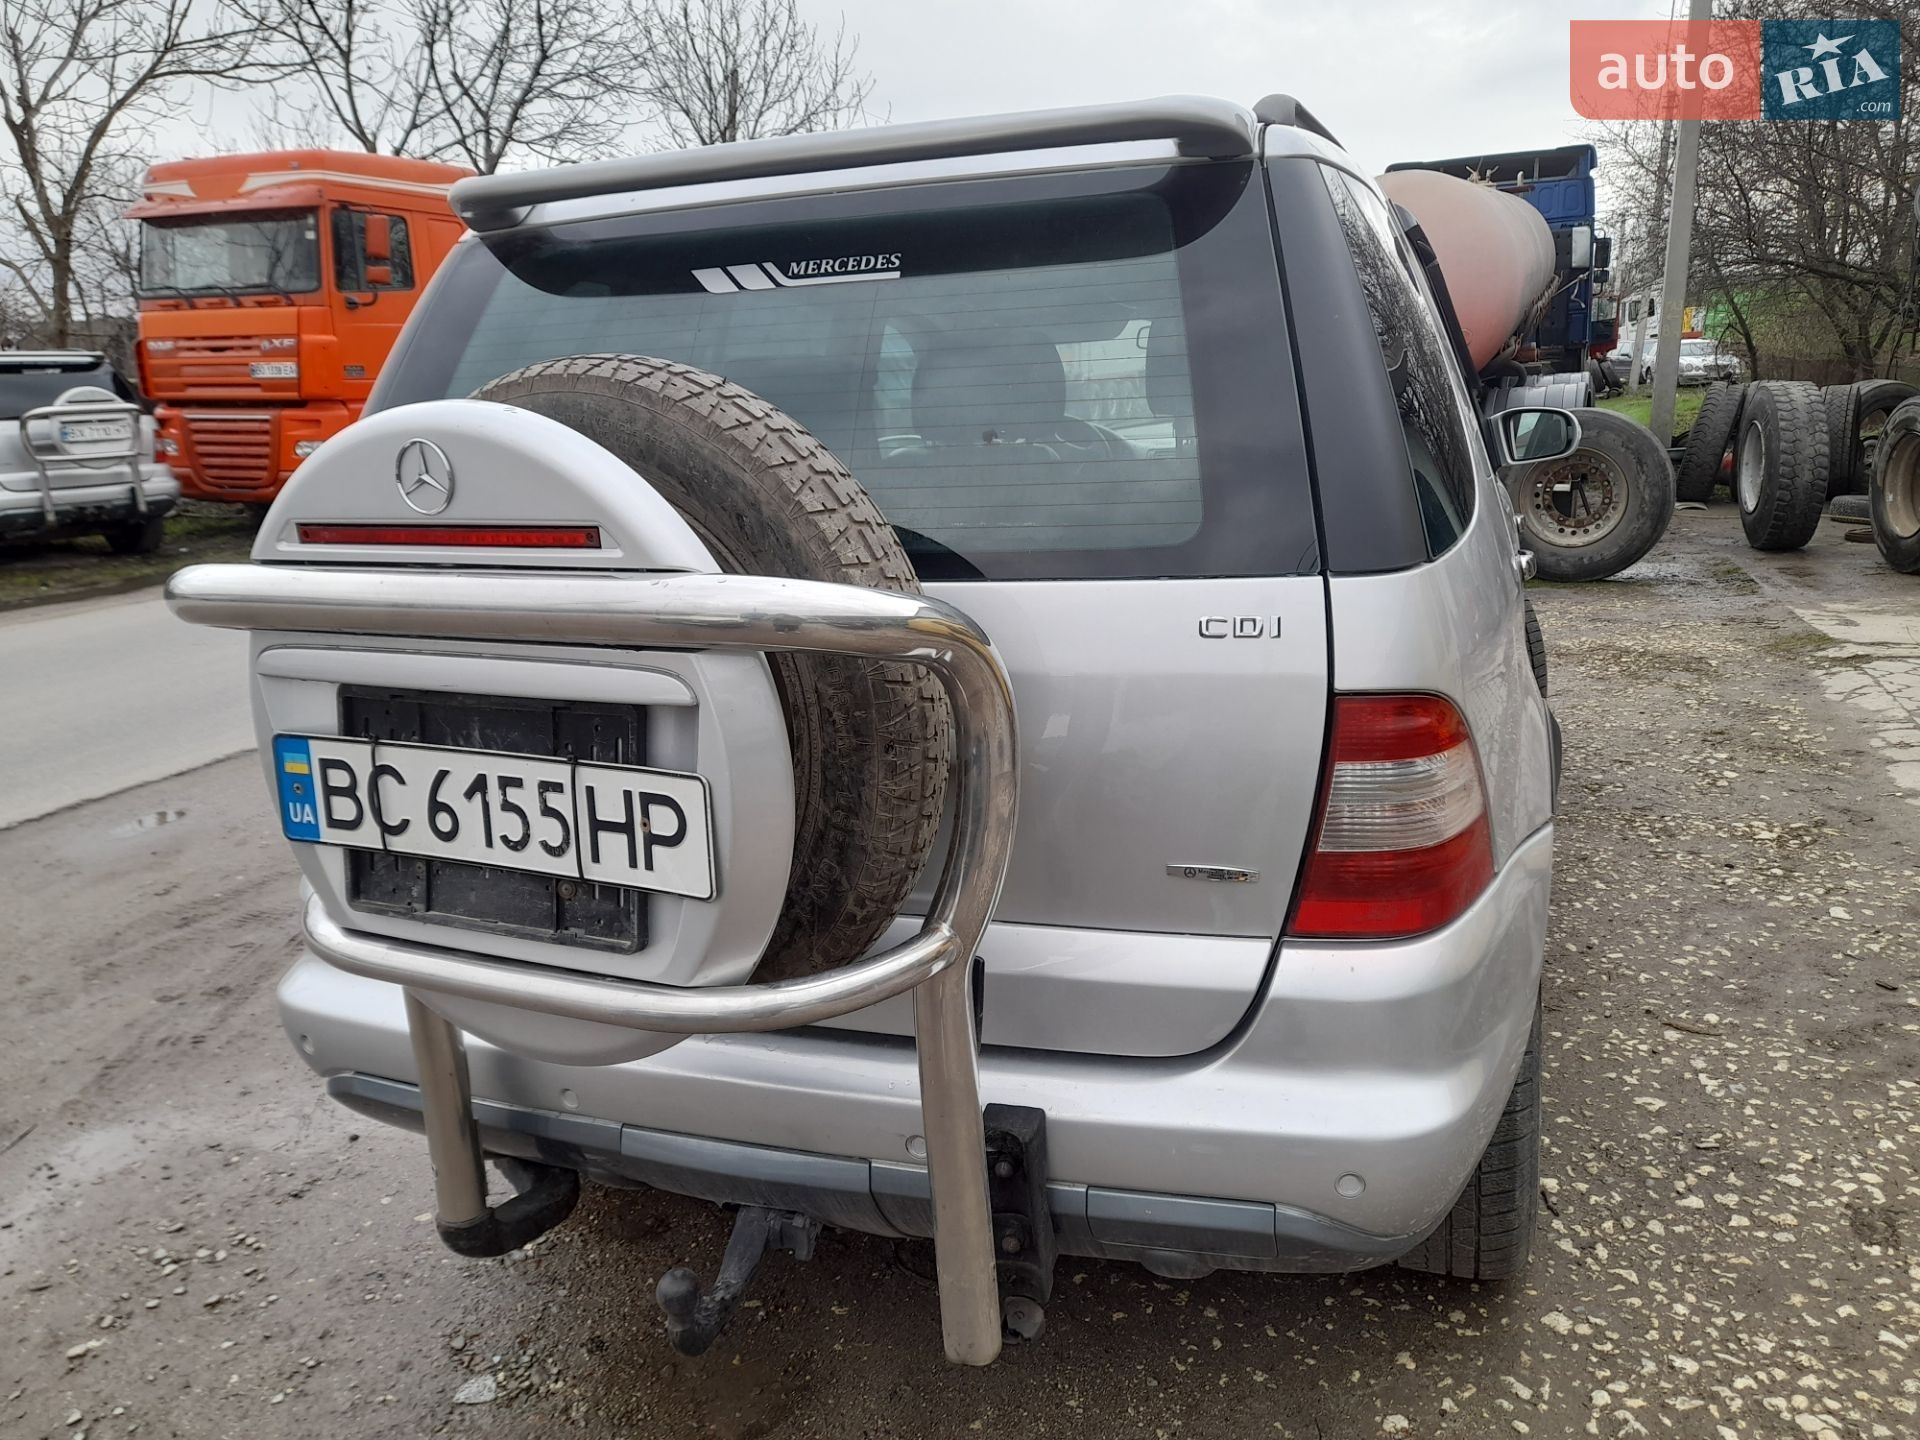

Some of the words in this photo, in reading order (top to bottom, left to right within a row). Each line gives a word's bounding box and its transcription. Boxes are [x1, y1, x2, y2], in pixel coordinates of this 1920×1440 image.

[786, 252, 903, 277] MERCEDES
[1198, 615, 1282, 639] CDI
[288, 799, 317, 826] UA
[317, 757, 411, 836] BC
[426, 768, 571, 858] 6155
[585, 784, 687, 871] HP
